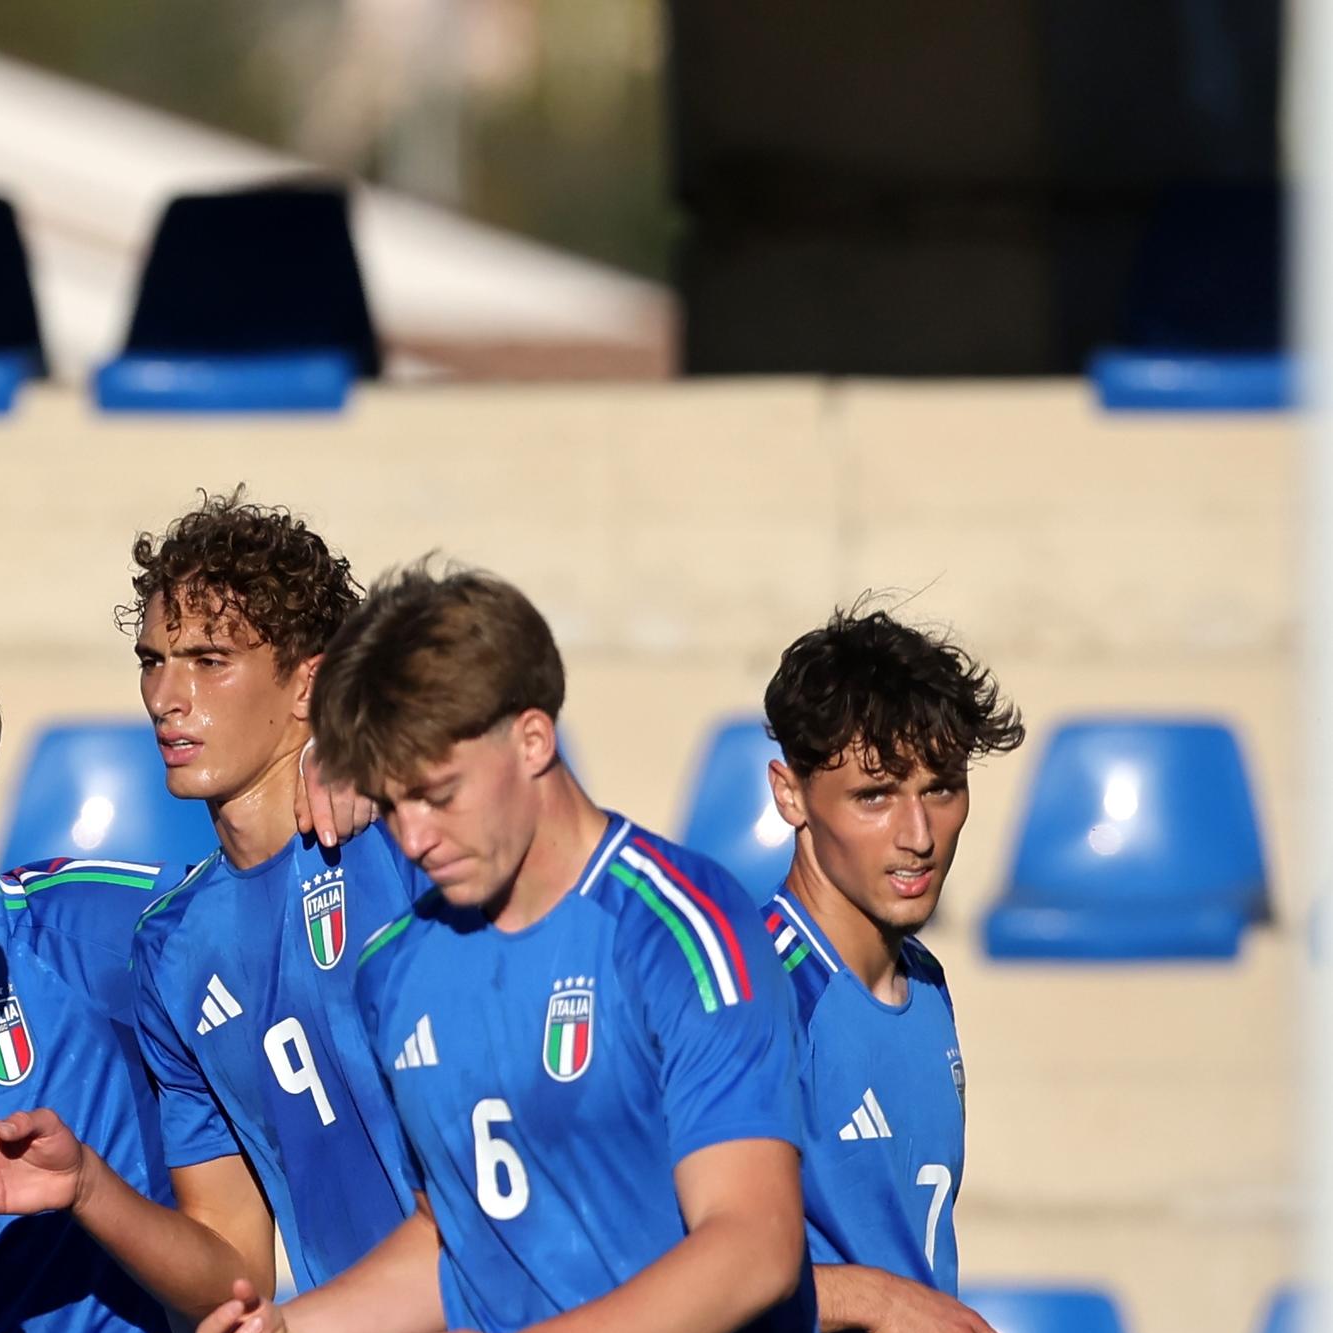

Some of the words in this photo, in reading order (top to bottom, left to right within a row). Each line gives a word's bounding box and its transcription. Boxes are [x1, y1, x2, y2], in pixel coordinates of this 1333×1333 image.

[308, 888, 341, 916] ITALIA
[551, 997, 589, 1017] ITALIA
[264, 1016, 337, 1126] 9
[472, 1098, 530, 1220] 6
[915, 1164, 951, 1271] 7
